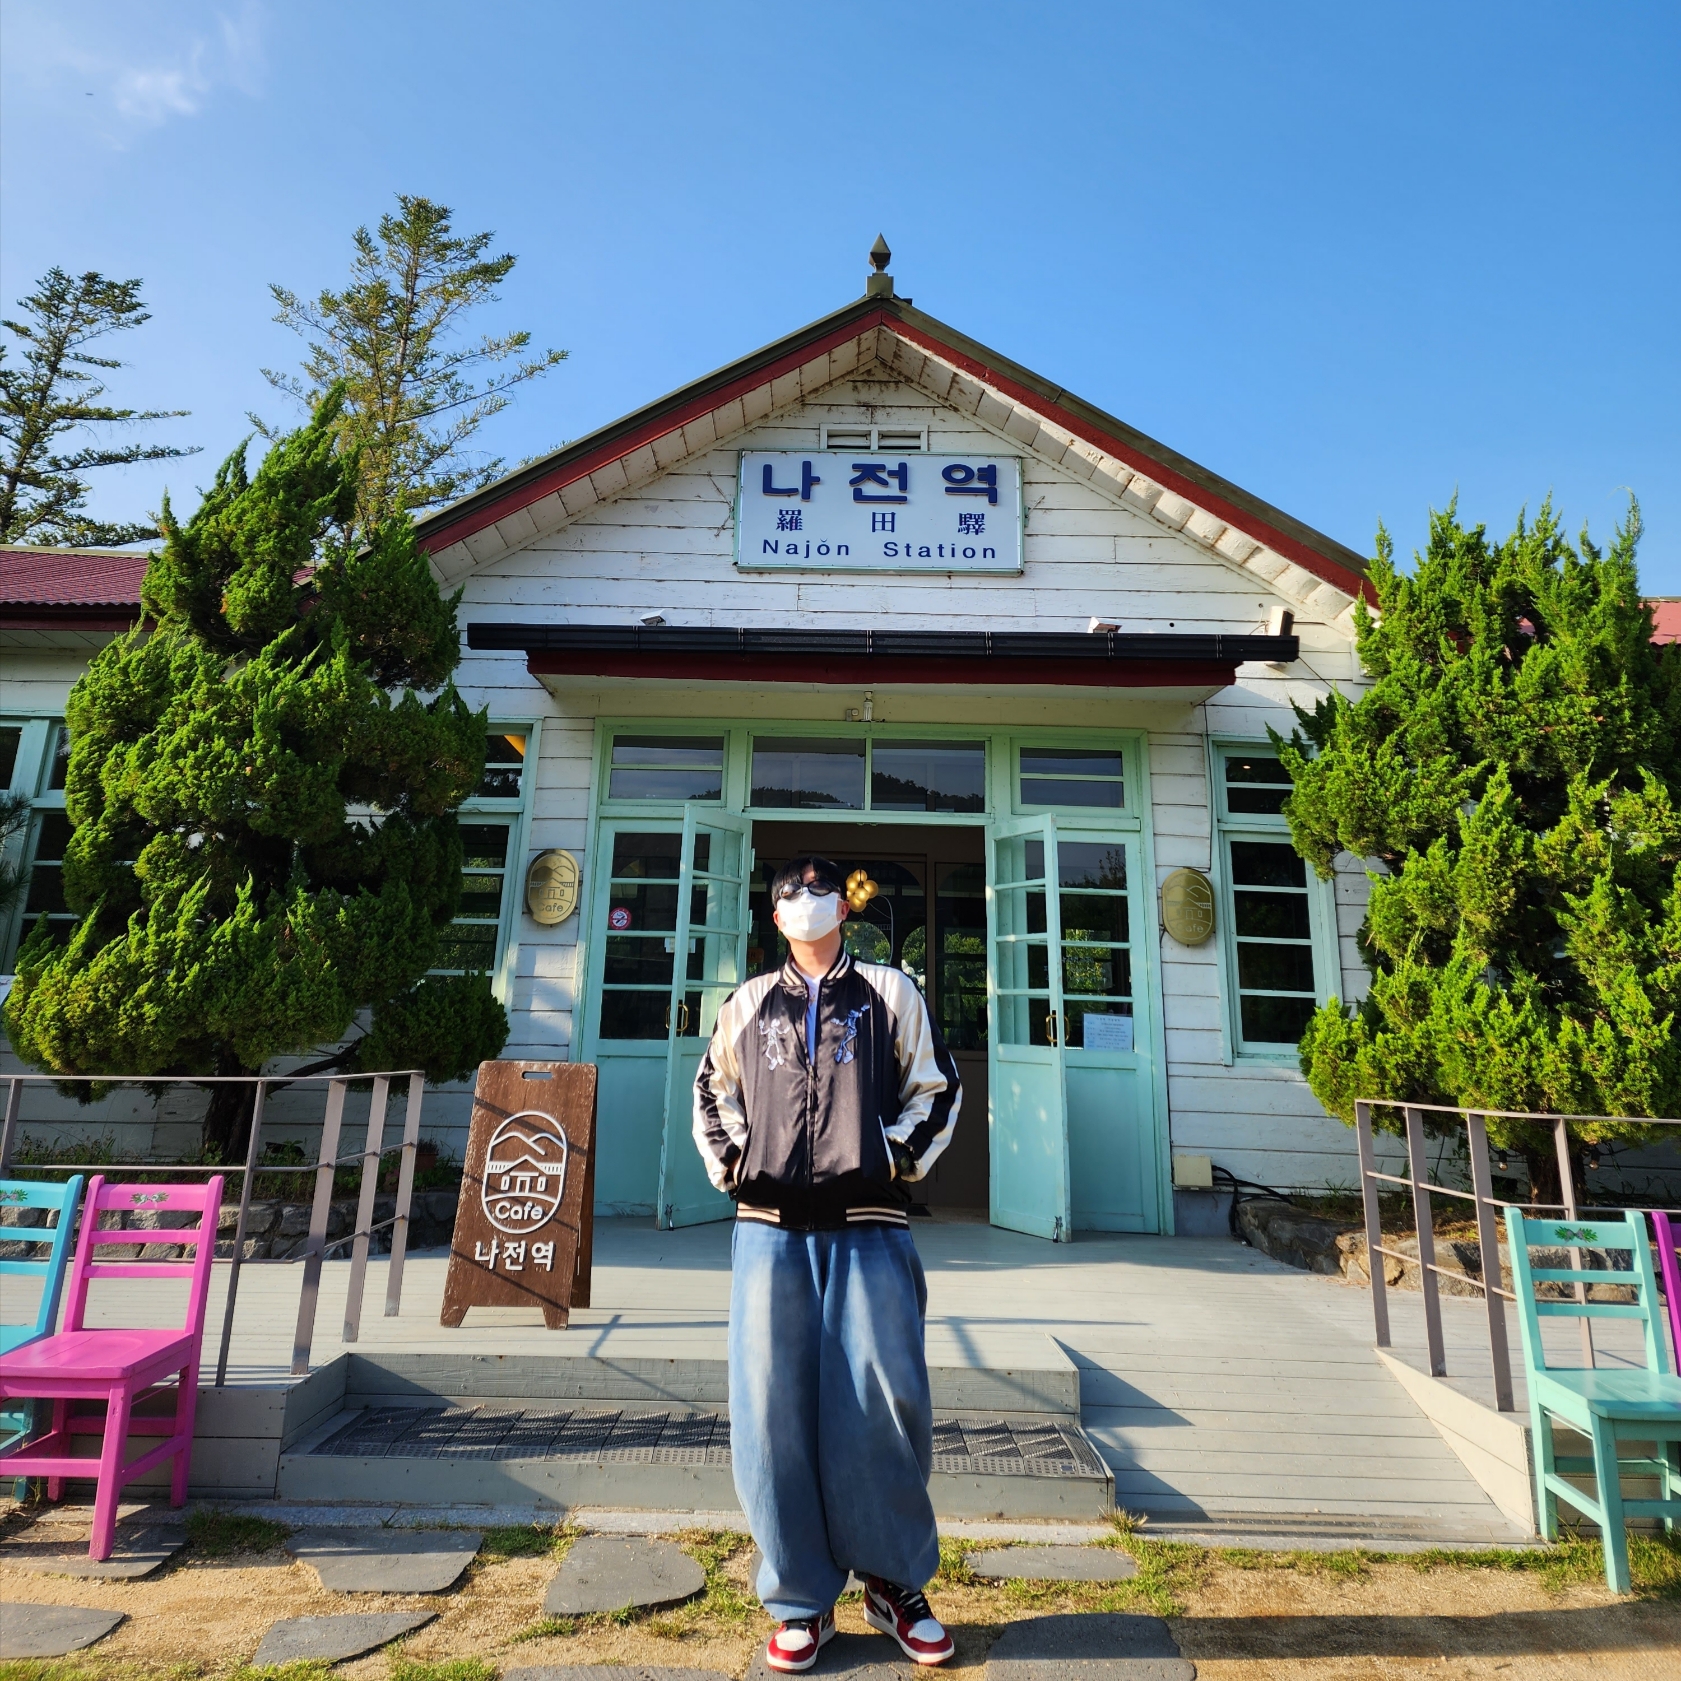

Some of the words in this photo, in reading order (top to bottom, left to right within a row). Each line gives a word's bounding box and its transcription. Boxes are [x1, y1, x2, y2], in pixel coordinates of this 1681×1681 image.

[762, 460, 998, 505] 나전역
[883, 541, 997, 559] Station
[537, 902, 564, 913] Cafe
[494, 1200, 544, 1220] Cafe
[474, 1239, 555, 1272] 나전역
